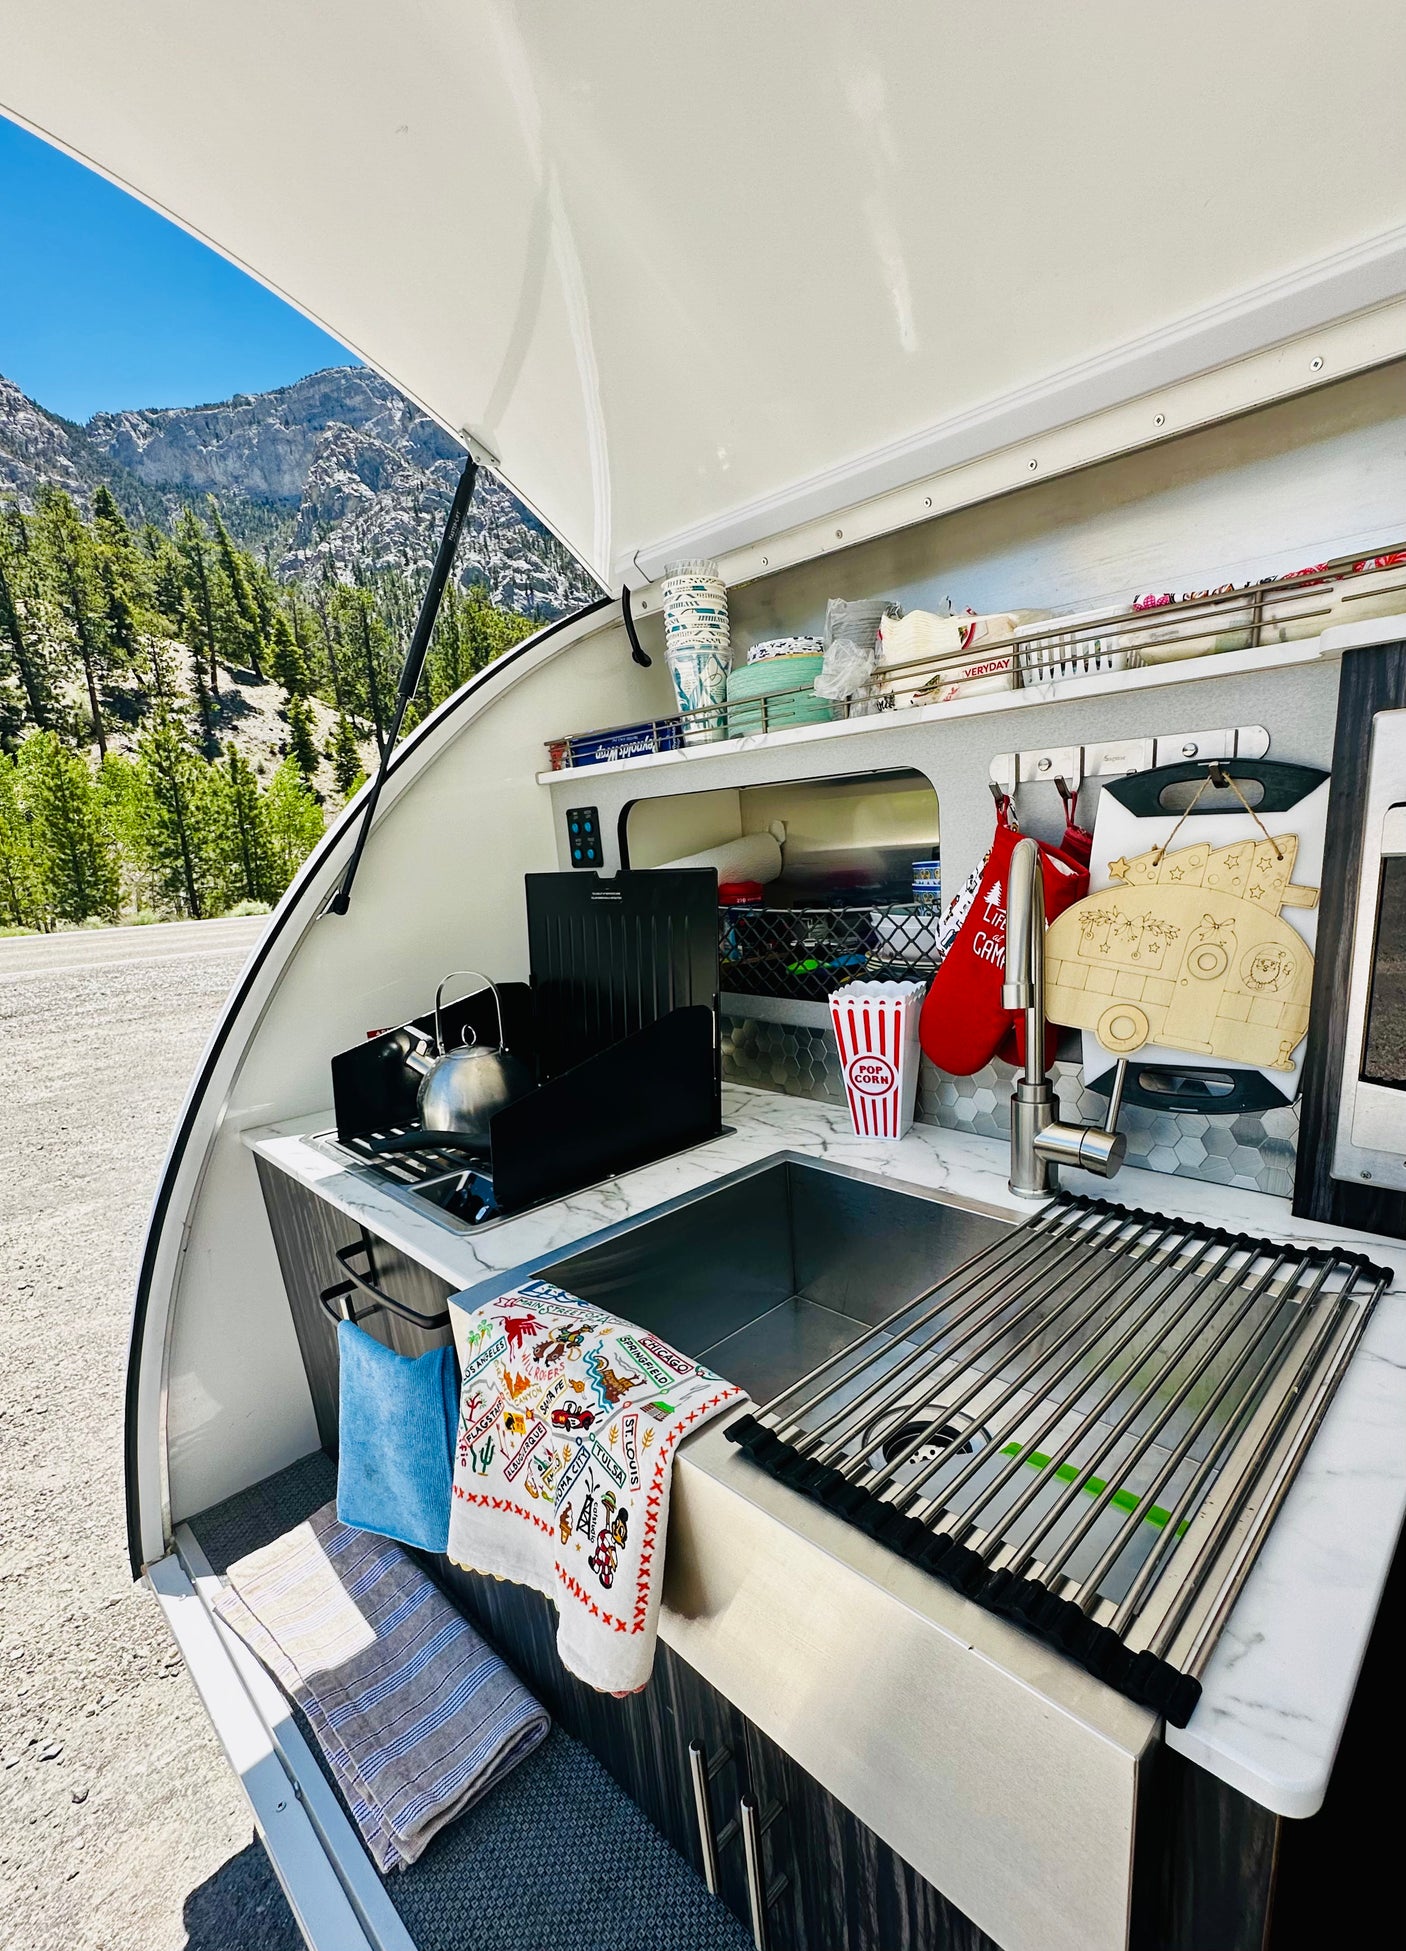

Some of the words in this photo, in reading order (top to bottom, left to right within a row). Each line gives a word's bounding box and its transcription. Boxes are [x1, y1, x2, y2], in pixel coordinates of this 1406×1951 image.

[964, 659, 1010, 677] VERYDAY
[983, 903, 1006, 931] LIFE
[992, 934, 1005, 943] at
[854, 1074, 889, 1085] CORN
[859, 1065, 883, 1075] POP
[517, 1299, 543, 1309] MAIN
[539, 1305, 586, 1316] STREET
[619, 1337, 668, 1385] SPRINGFIELD
[642, 1337, 689, 1372] CHICAGO
[515, 1386, 543, 1406] CANYON
[554, 1379, 565, 1394] FE
[625, 1418, 635, 1437] ST.
[572, 1449, 588, 1474] CITY
[595, 1445, 623, 1480] TULSA
[626, 1442, 638, 1485] LOUIS
[590, 1501, 599, 1544] catstudio
